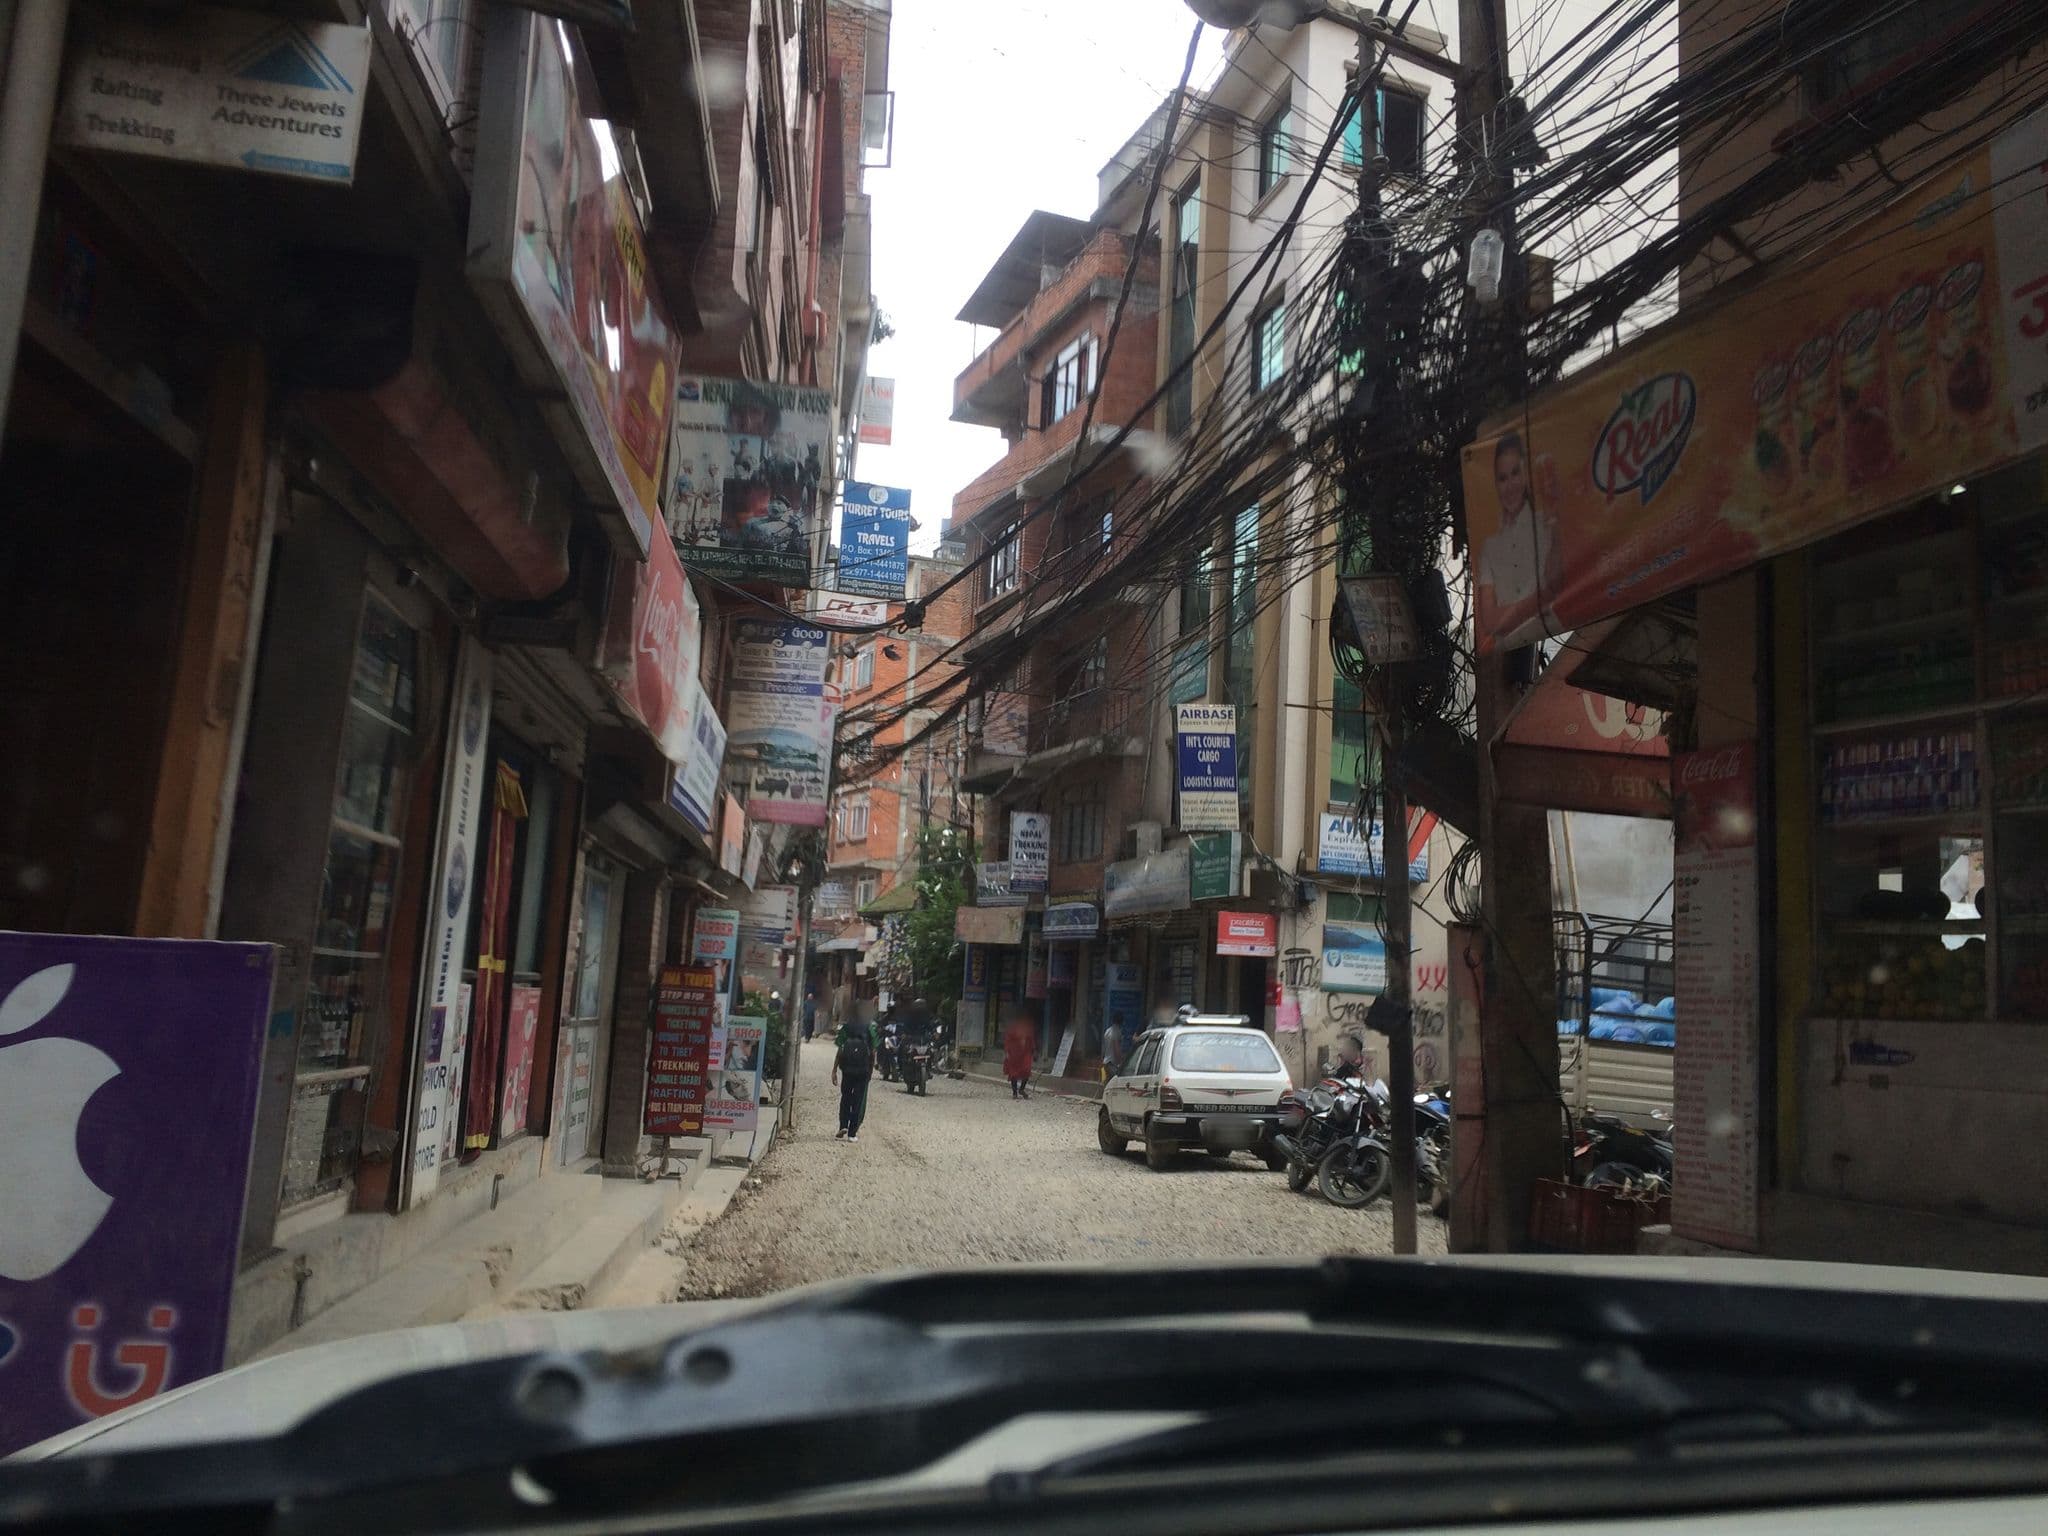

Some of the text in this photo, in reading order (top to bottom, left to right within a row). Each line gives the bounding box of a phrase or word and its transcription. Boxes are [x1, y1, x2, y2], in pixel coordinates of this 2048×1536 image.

[90, 76, 164, 107] Rafting
[216, 84, 347, 118] Three Jewels
[210, 105, 343, 139] Adventures
[85, 113, 175, 146] Trekking
[1606, 373, 1682, 505] Real
[843, 502, 909, 521] TURRET TOURS
[856, 532, 896, 547] TRAVELS
[791, 627, 824, 641] GOOD
[1180, 708, 1234, 720] AIRBASE
[1185, 735, 1231, 750] INT'L COURIER
[1197, 750, 1220, 763] CARGO
[1206, 763, 1212, 776] &
[1681, 744, 1744, 786] Coca-Cola
[1183, 776, 1236, 789] LOGISTICS SERVICE
[1020, 829, 1042, 839] NEPAL
[1013, 840, 1048, 851] TREKKING
[1015, 851, 1046, 862] EXPERTS
[699, 939, 726, 954] SHOP
[735, 1027, 763, 1040] SHOP
[659, 1046, 694, 1057] TO TIBET
[656, 1060, 700, 1072] TREKKING
[679, 1074, 702, 1086] SAFARI
[653, 1088, 696, 1099] RAFTING
[667, 1103, 683, 1113] TRAIN
[683, 1104, 703, 1114] SERVICE
[709, 1100, 756, 1112] DRESSER
[1193, 1104, 1266, 1114] NEED FOR SPEED
[414, 1144, 437, 1173] STORE
